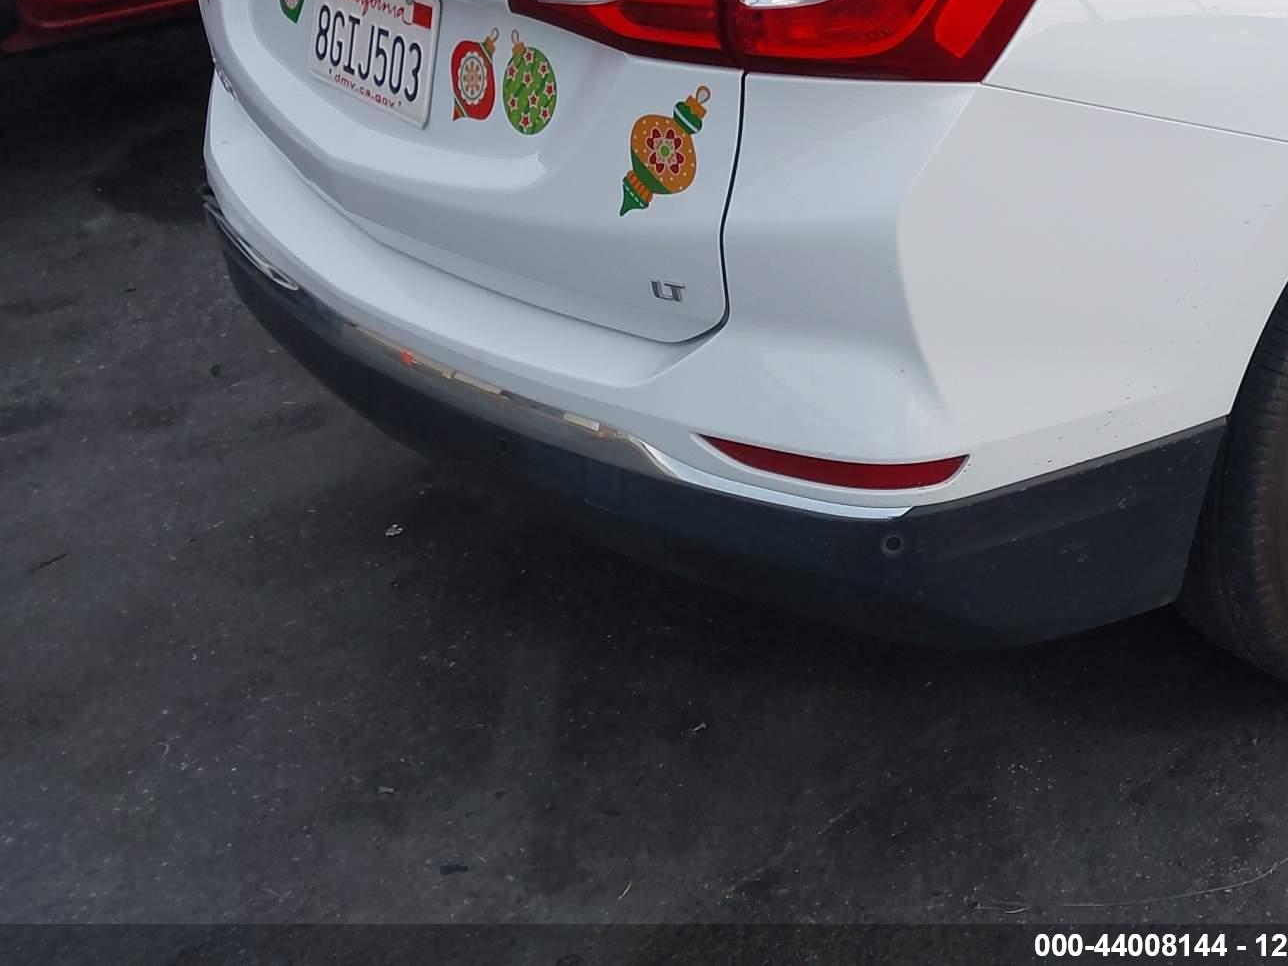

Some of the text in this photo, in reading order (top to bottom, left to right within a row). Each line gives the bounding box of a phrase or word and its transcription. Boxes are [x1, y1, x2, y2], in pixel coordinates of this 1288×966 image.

[315, 4, 422, 102] 8GIJ503
[334, 73, 395, 108] dmv.ca.gov
[650, 280, 686, 302] LT
